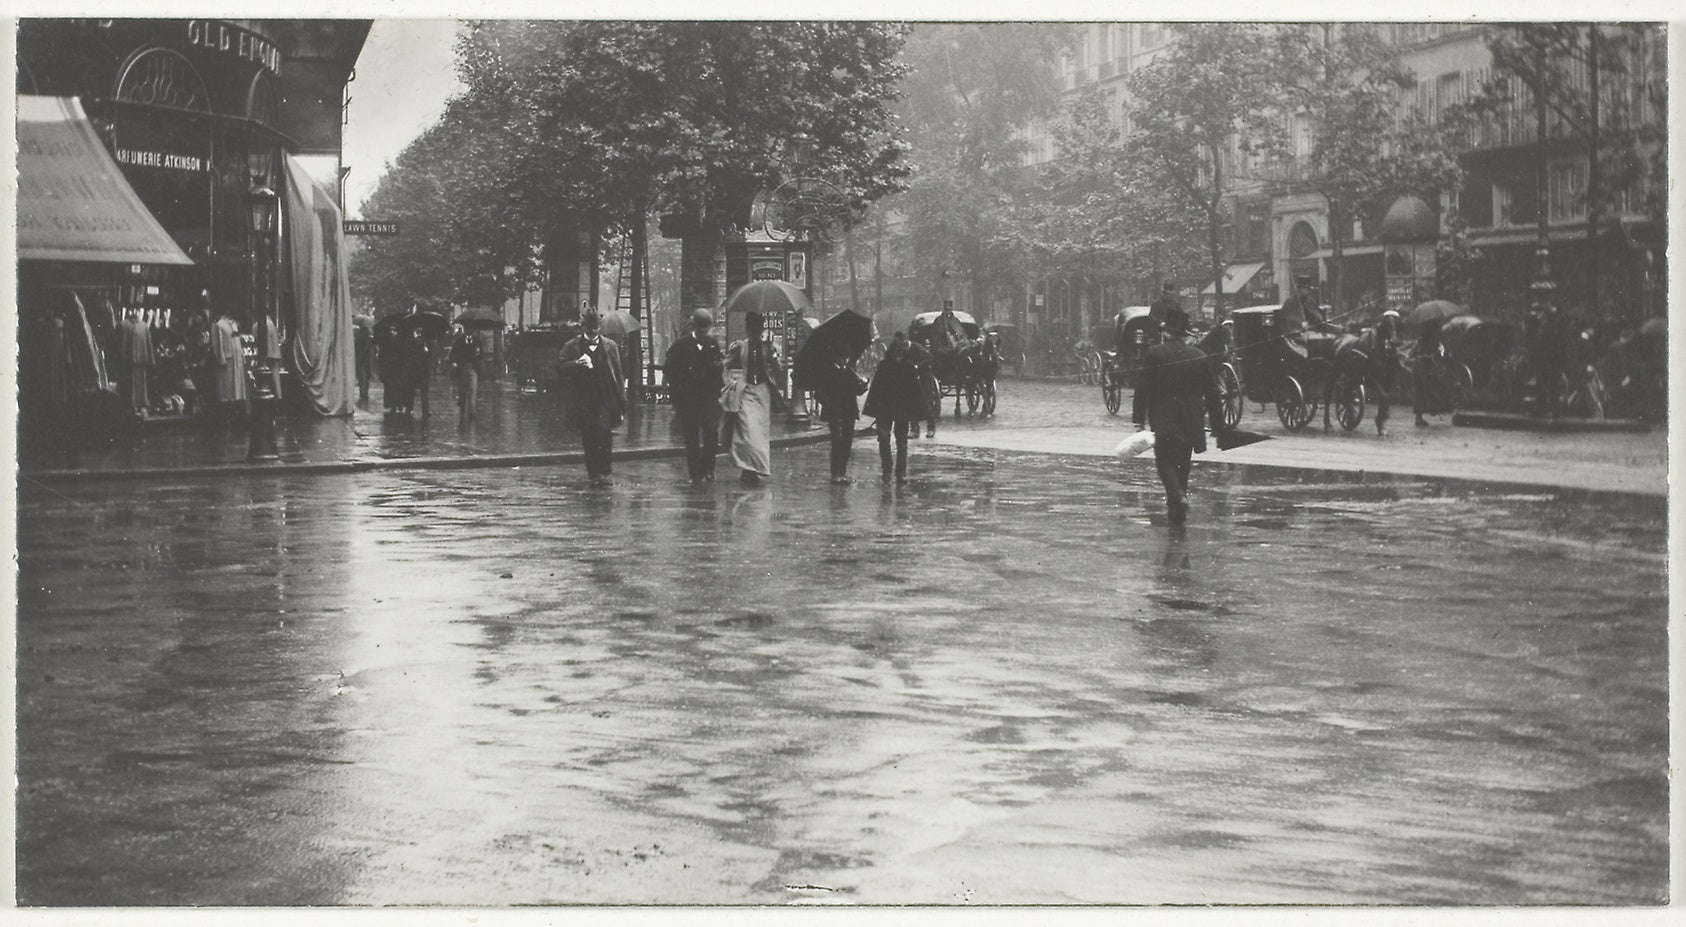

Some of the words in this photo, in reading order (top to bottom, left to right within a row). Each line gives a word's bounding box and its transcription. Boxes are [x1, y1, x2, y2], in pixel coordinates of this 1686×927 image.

[188, 20, 229, 51] OLD
[164, 154, 200, 171] ATKINSON
[344, 224, 365, 232] LAWN
[368, 224, 396, 233] TENNIS
